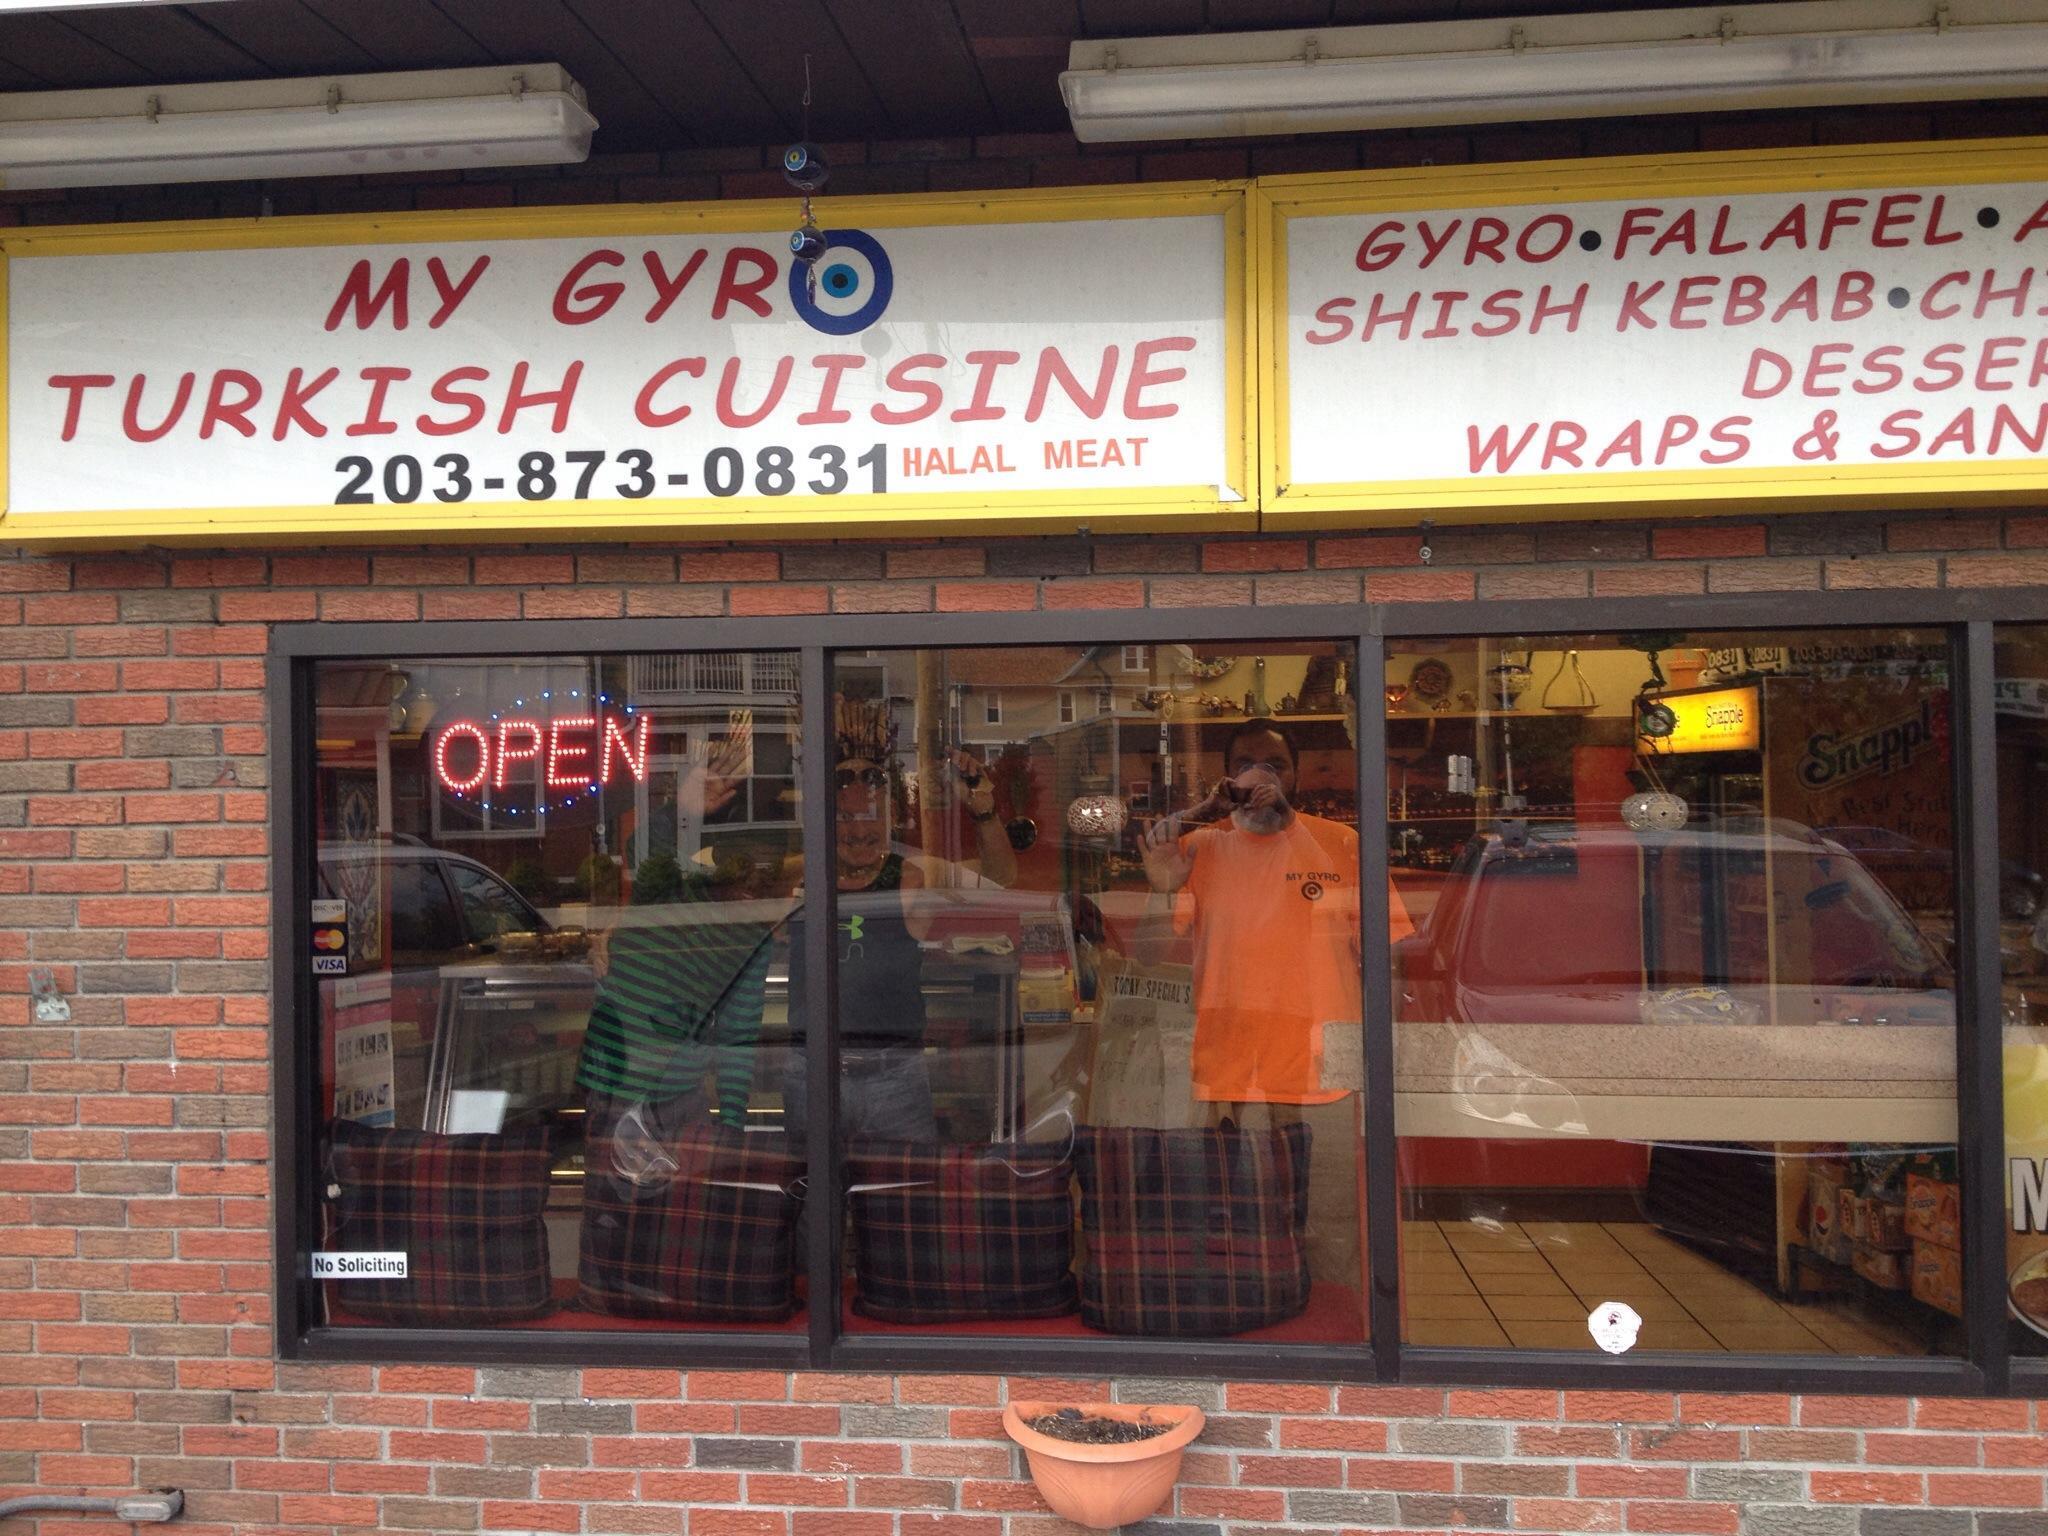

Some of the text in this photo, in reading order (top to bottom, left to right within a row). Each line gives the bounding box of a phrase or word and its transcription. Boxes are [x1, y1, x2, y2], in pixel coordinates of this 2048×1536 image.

[1355, 214, 1573, 272] GYRO
[1614, 193, 1962, 260] FALAFEL
[324, 255, 490, 331] MY
[1306, 265, 2048, 344] SHISH KEBAB CH
[48, 336, 1197, 443] TURKISH CUISINE
[903, 437, 1148, 476] HALAL MEAT
[1467, 402, 2048, 473] WRAPS & SAN
[335, 443, 888, 503] 203-873-0831
[1706, 704, 1743, 731] Snapple
[1804, 699, 1932, 785] Snappl
[435, 714, 649, 790] OPEN
[1285, 871, 1341, 883] MY GYRO
[316, 959, 345, 970] VISA
[1145, 979, 1191, 1004] SPECIAL'S
[314, 1257, 405, 1276] No Soliciting
